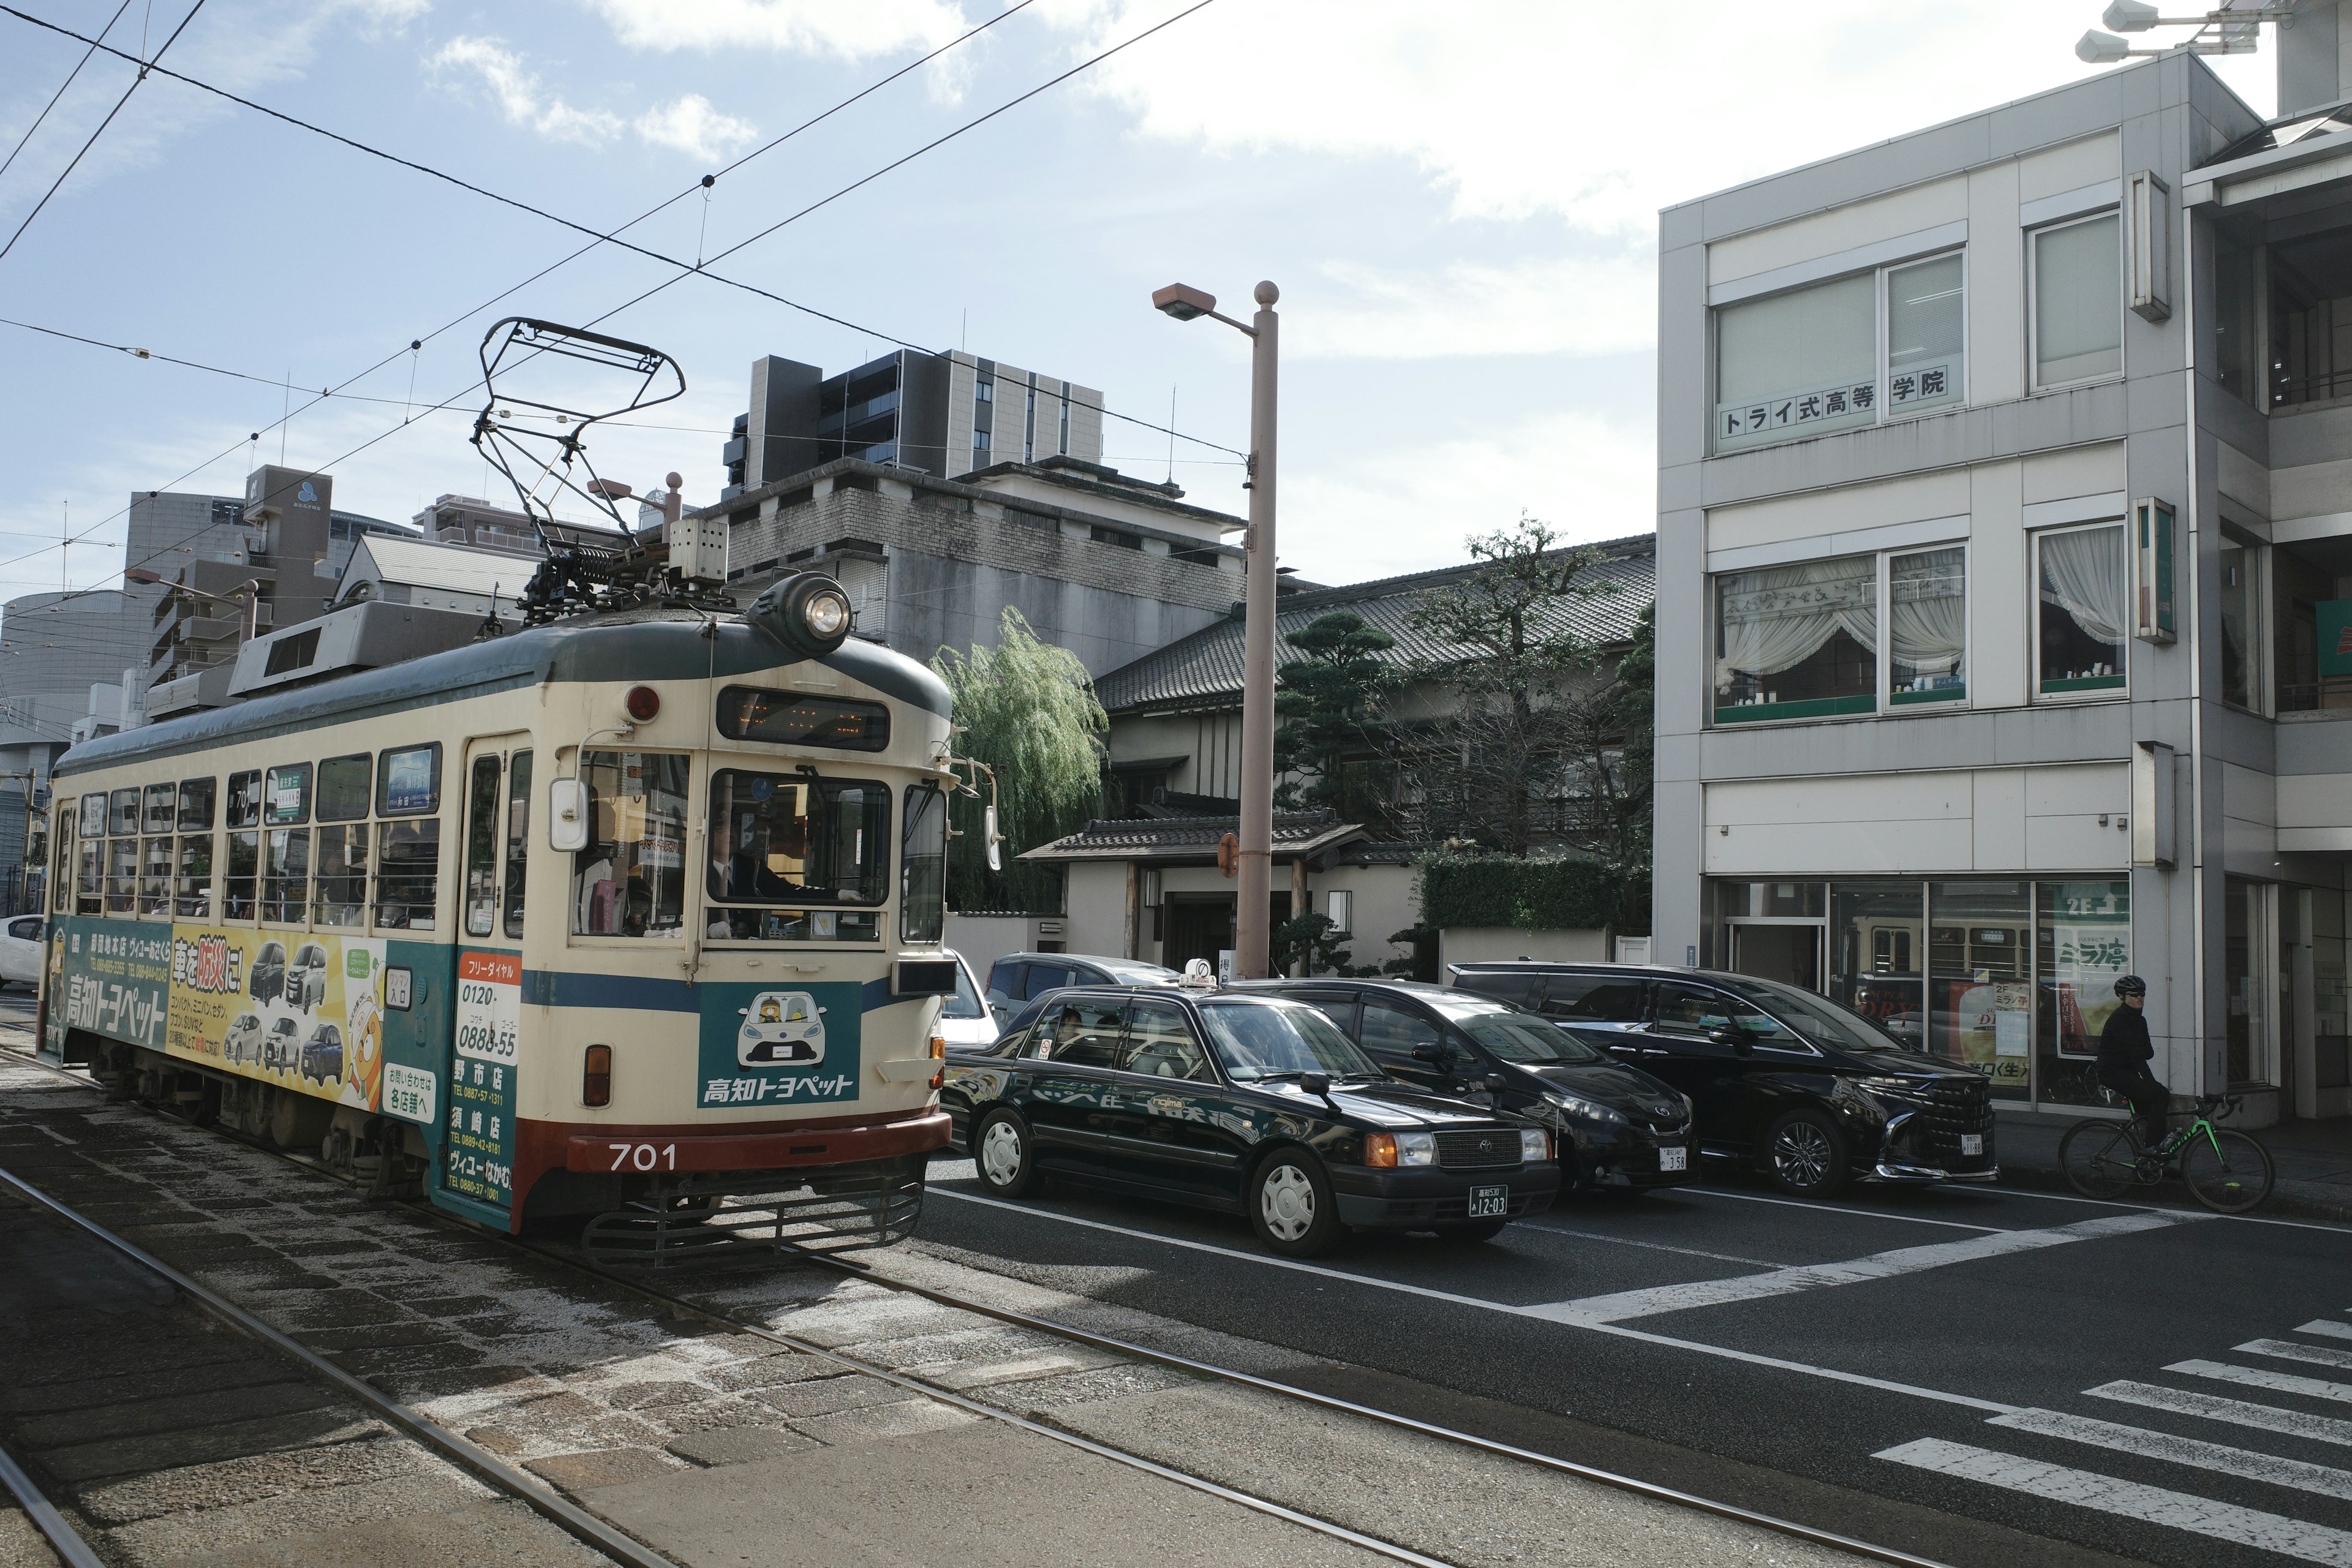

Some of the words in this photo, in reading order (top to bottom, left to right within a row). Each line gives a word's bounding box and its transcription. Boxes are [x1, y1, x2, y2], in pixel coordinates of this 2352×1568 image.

[1727, 385, 1874, 435] トライ式高等
[1892, 370, 1944, 401] 学院
[2067, 898, 2092, 915] 2F
[129, 935, 171, 962] ヴィユーあさくら
[2059, 937, 2128, 973] ミラノ亭
[469, 960, 513, 979] フリーダイヤル
[390, 973, 409, 987] ワンマン
[391, 989, 405, 1003] 入口
[1996, 996, 2028, 1006] ミラノ亭
[66, 973, 165, 1045] 高知トヨペット
[470, 1014, 483, 1024] コウチ
[502, 1019, 517, 1030] ゴーゴー
[390, 1069, 431, 1091] お問い合わせは
[704, 1074, 854, 1102] 高知トヨペット
[453, 1084, 462, 1096] TEL
[391, 1087, 427, 1115] 各店舗へ
[1153, 1098, 1182, 1108] nojima
[451, 1131, 461, 1144] TEL
[609, 1144, 676, 1171] 701
[450, 1150, 513, 1190] ヴィユーなかむ
[448, 1174, 458, 1188] TEL
[1479, 1188, 1499, 1197] 高知530
